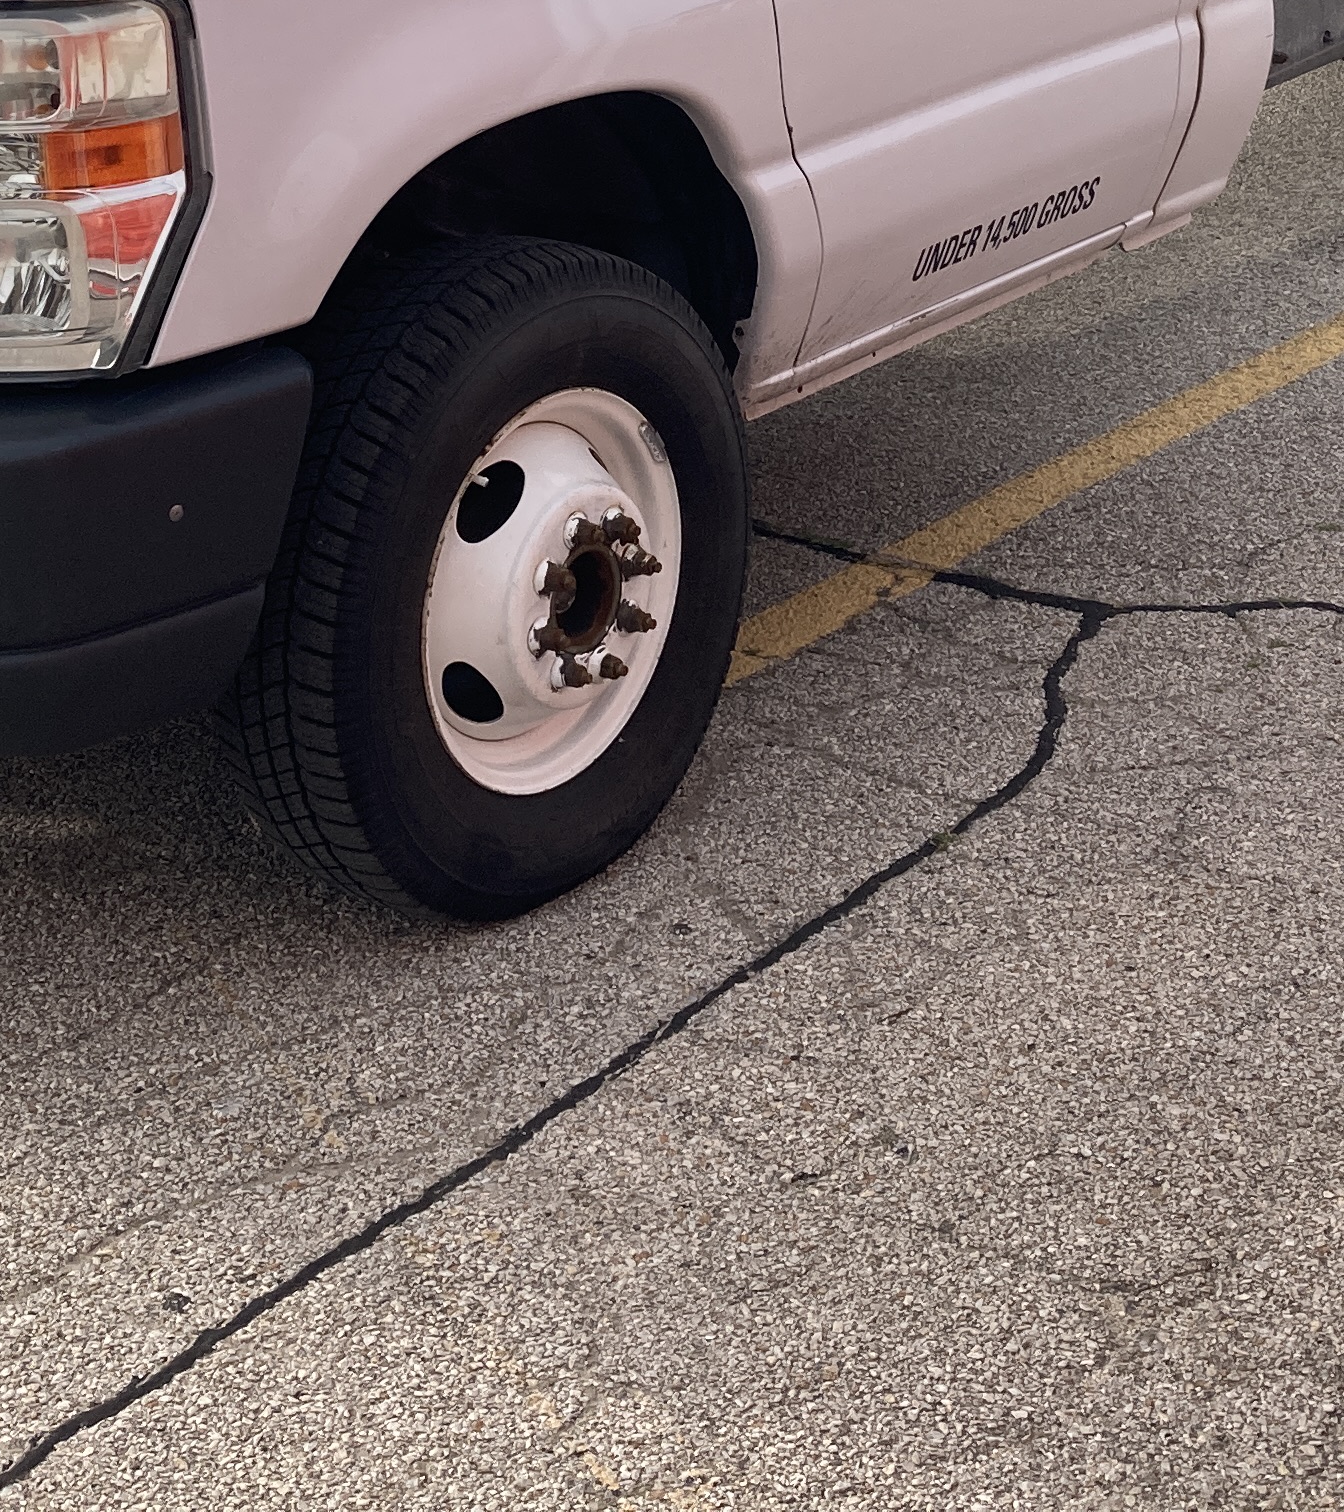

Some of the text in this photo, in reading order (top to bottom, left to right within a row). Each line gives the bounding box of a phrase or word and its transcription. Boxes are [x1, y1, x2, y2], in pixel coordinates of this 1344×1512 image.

[912, 176, 1101, 282] UNDER 14,500 GROSS
